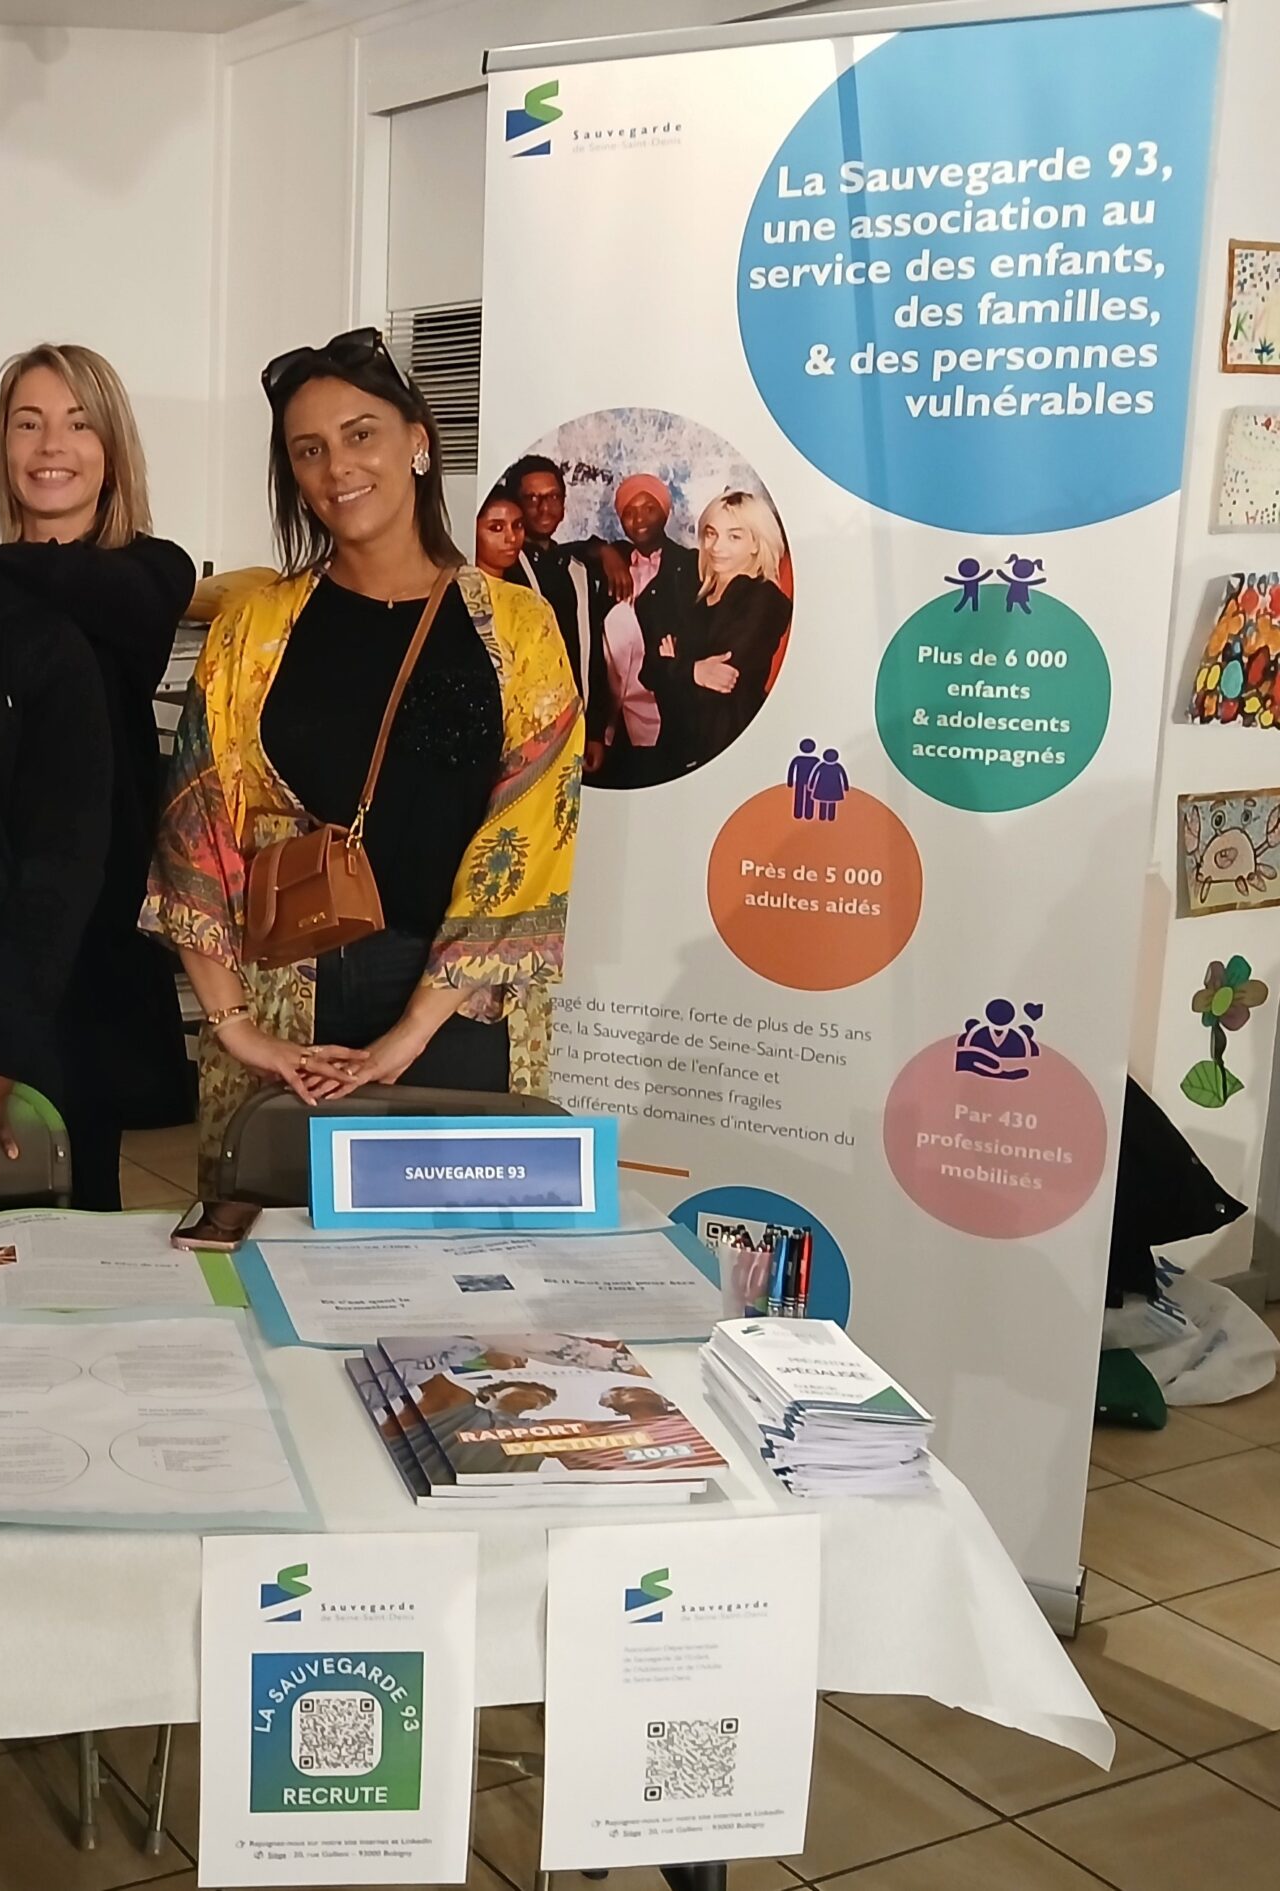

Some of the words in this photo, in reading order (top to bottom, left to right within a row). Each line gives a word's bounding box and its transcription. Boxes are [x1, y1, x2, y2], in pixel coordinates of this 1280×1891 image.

[573, 121, 682, 140] Sauvegarde
[777, 165, 826, 199] La
[838, 148, 1092, 195] Sauvegarde
[1107, 140, 1174, 183] 93,
[762, 218, 837, 245] une
[850, 195, 1087, 240] association
[1101, 199, 1156, 228] au
[748, 254, 892, 290] service
[905, 248, 977, 283] des
[989, 242, 1167, 281] enfants,
[893, 295, 964, 329] des
[977, 288, 1162, 329] familles,
[804, 343, 837, 377] &
[849, 340, 920, 375] des
[931, 339, 1160, 382] personnes
[905, 381, 1156, 419] vulnérables
[917, 645, 963, 667] Plus
[969, 648, 997, 667] de
[1004, 648, 1019, 668] 6
[1025, 649, 1068, 670] 000
[946, 679, 1031, 701] enfants
[911, 707, 930, 727] &
[936, 710, 1071, 734] adolescents
[911, 741, 1067, 768] accompagnés
[740, 860, 787, 881] Près
[792, 864, 819, 882] de
[824, 866, 838, 884] 5
[843, 867, 883, 886] 000
[744, 890, 821, 912] adultes
[825, 896, 882, 917] aidés
[586, 996, 606, 1012] du
[610, 1000, 684, 1022] territoire,
[689, 1006, 729, 1026] forte
[732, 1013, 753, 1028] de
[757, 1016, 789, 1035] plus
[793, 1021, 814, 1036] de
[819, 1022, 840, 1039] 55
[844, 1028, 873, 1042] ans
[577, 1021, 588, 1035] la
[593, 1023, 680, 1046] Sauvegarde
[684, 1034, 704, 1049] de
[709, 1036, 848, 1067] Seine-Saint-Denis
[567, 1045, 579, 1060] la
[583, 1050, 663, 1070] protection
[667, 1057, 687, 1072] de
[691, 1059, 760, 1082] l'enfance
[763, 1071, 780, 1084] et
[614, 1077, 640, 1092] des
[644, 1083, 724, 1103] personnes
[728, 1089, 782, 1112] fragiles
[567, 1096, 639, 1117] différents
[643, 1105, 716, 1127] domaines
[720, 1116, 829, 1143] d'intervention
[834, 1132, 856, 1147] du
[954, 1103, 992, 1124] Par
[998, 1110, 1038, 1130] 430
[916, 1131, 1073, 1164] professionnels
[404, 1166, 505, 1181] SAUVEGARDE
[507, 1166, 527, 1180] 93
[940, 1163, 1043, 1190] mobilisés
[459, 1422, 583, 1443] RAPPORT
[321, 1602, 415, 1613] Sauvegarde
[681, 1601, 769, 1612] Sauvegarde
[254, 1706, 276, 1733] LA
[268, 1656, 409, 1704] SAUVEGARDE
[399, 1705, 420, 1732] 93
[283, 1786, 388, 1805] RECRUTE
